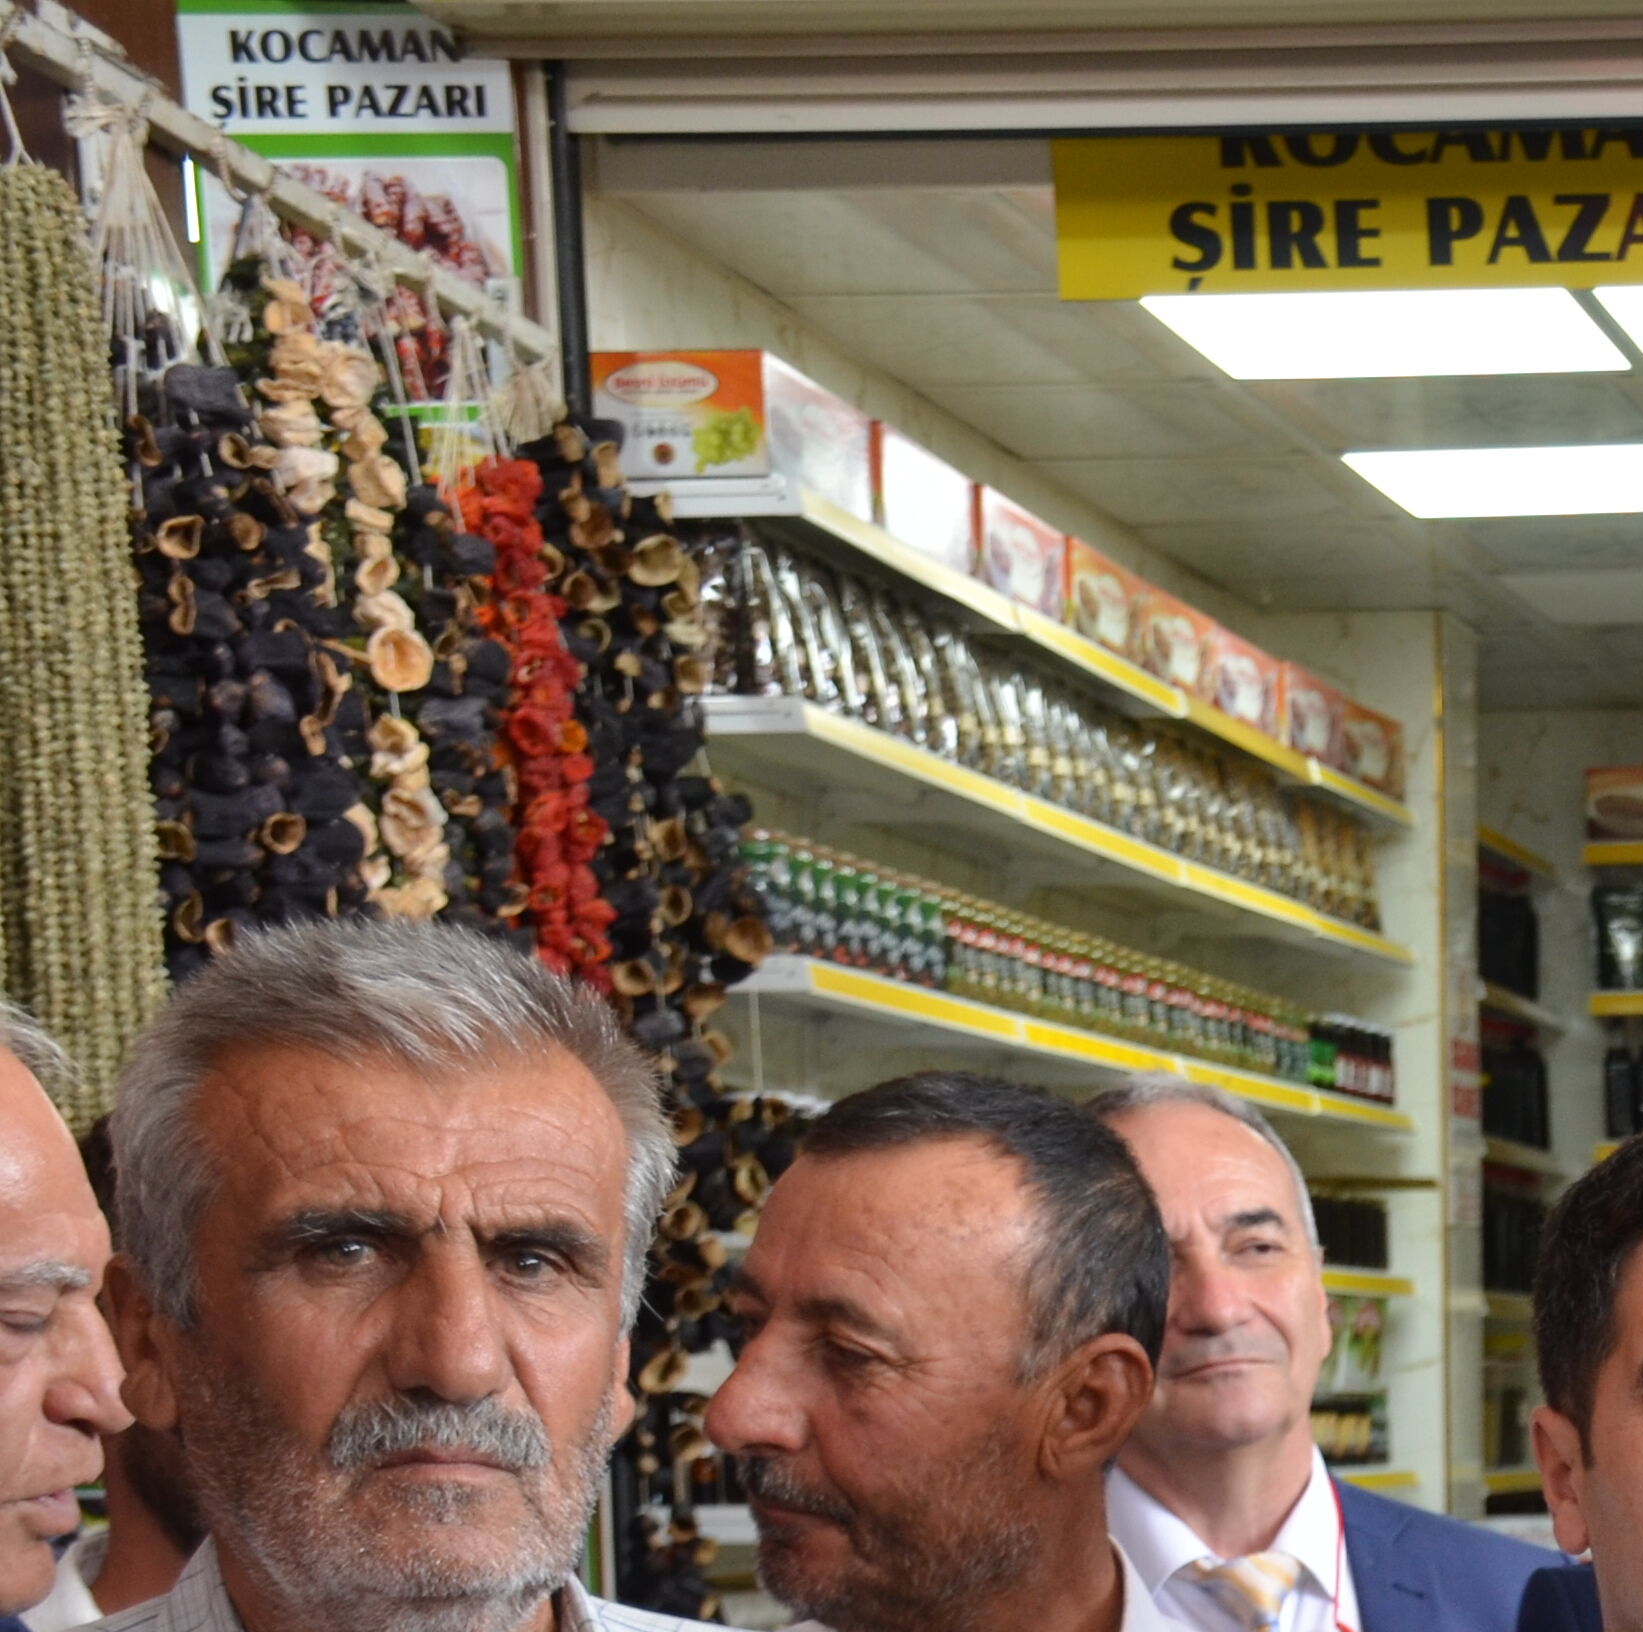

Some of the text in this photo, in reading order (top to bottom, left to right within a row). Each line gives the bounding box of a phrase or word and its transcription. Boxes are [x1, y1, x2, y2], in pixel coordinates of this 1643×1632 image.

[229, 29, 461, 64] KOCAMAN
[210, 76, 488, 129] ŞİRE PAZARI
[1168, 183, 1382, 291] ŞİRE
